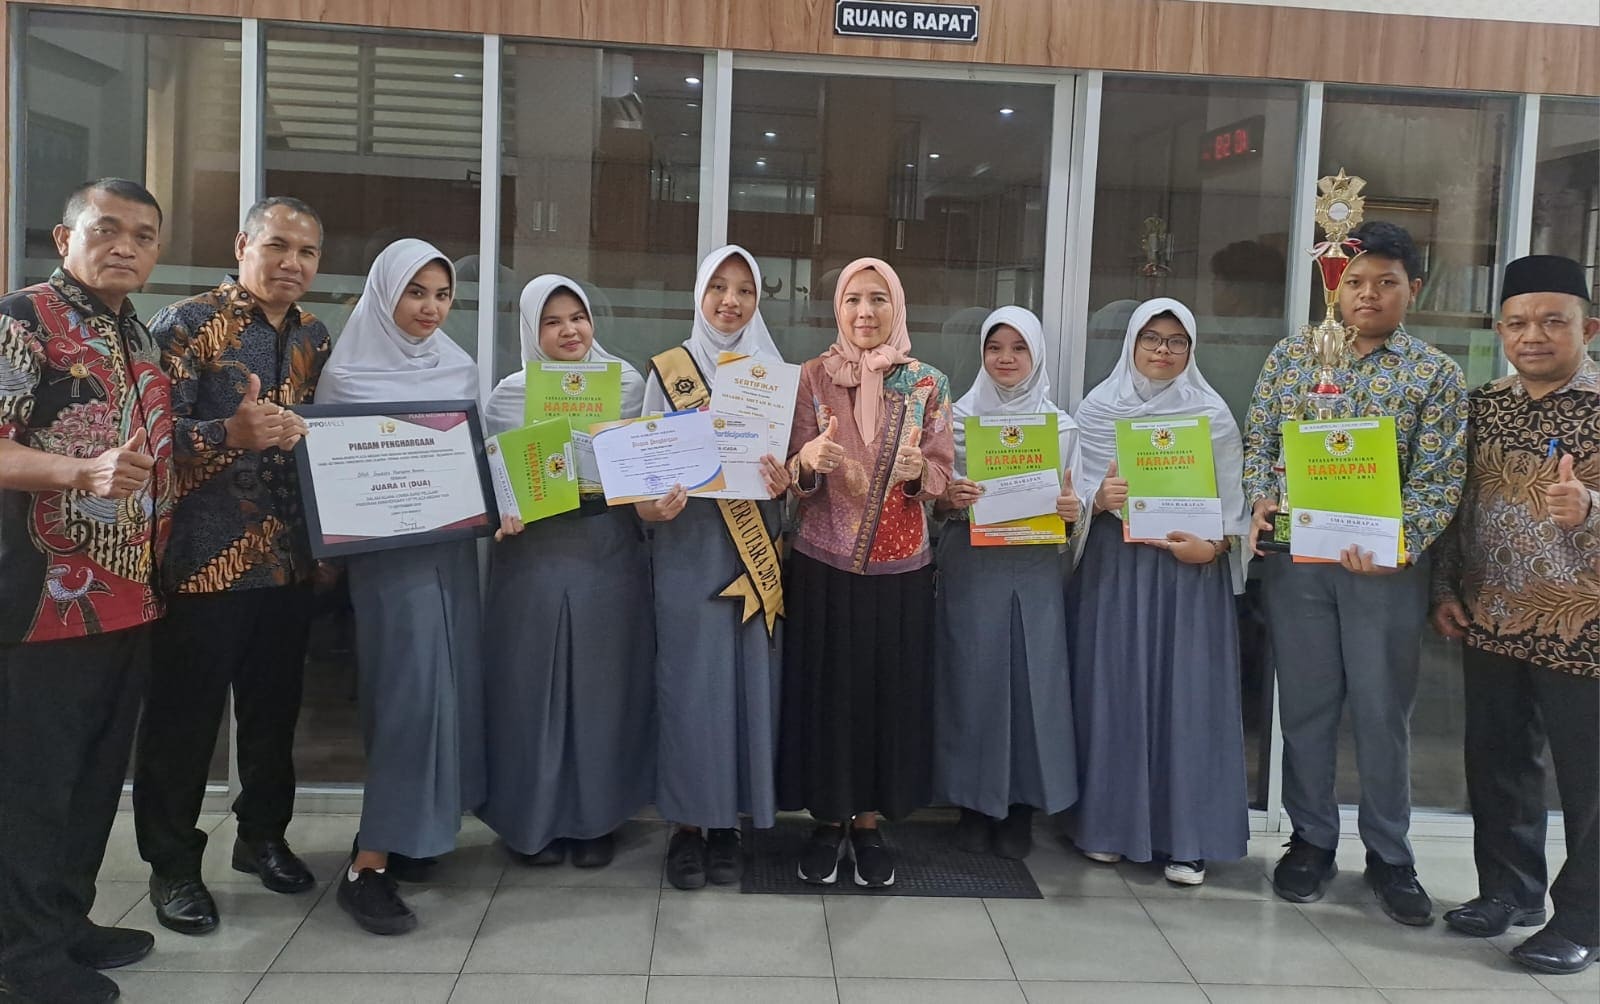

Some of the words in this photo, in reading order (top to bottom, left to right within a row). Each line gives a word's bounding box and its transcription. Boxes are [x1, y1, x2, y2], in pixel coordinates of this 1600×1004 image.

[842, 7, 907, 28] RUANG
[912, 12, 972, 32] RAPAT
[734, 378, 779, 392] SERTIFIKAT
[543, 401, 604, 413] HARAPAN
[379, 421, 396, 434] 19
[348, 441, 380, 451] PIAGAM
[380, 438, 435, 449] PENGHARGAAN
[985, 453, 1043, 465] HARAPAN
[1136, 455, 1195, 467] HARAPAN
[528, 442, 544, 501] HARAPAN
[1308, 463, 1377, 475] HARAPAN
[371, 482, 398, 491] JUARA
[400, 481, 406, 489] II
[408, 480, 431, 489] (DUA)
[1014, 476, 1041, 485] HARAPAN
[1346, 519, 1379, 527] HARAPAN
[741, 524, 769, 569] UTARA
[758, 563, 778, 591] 2023
